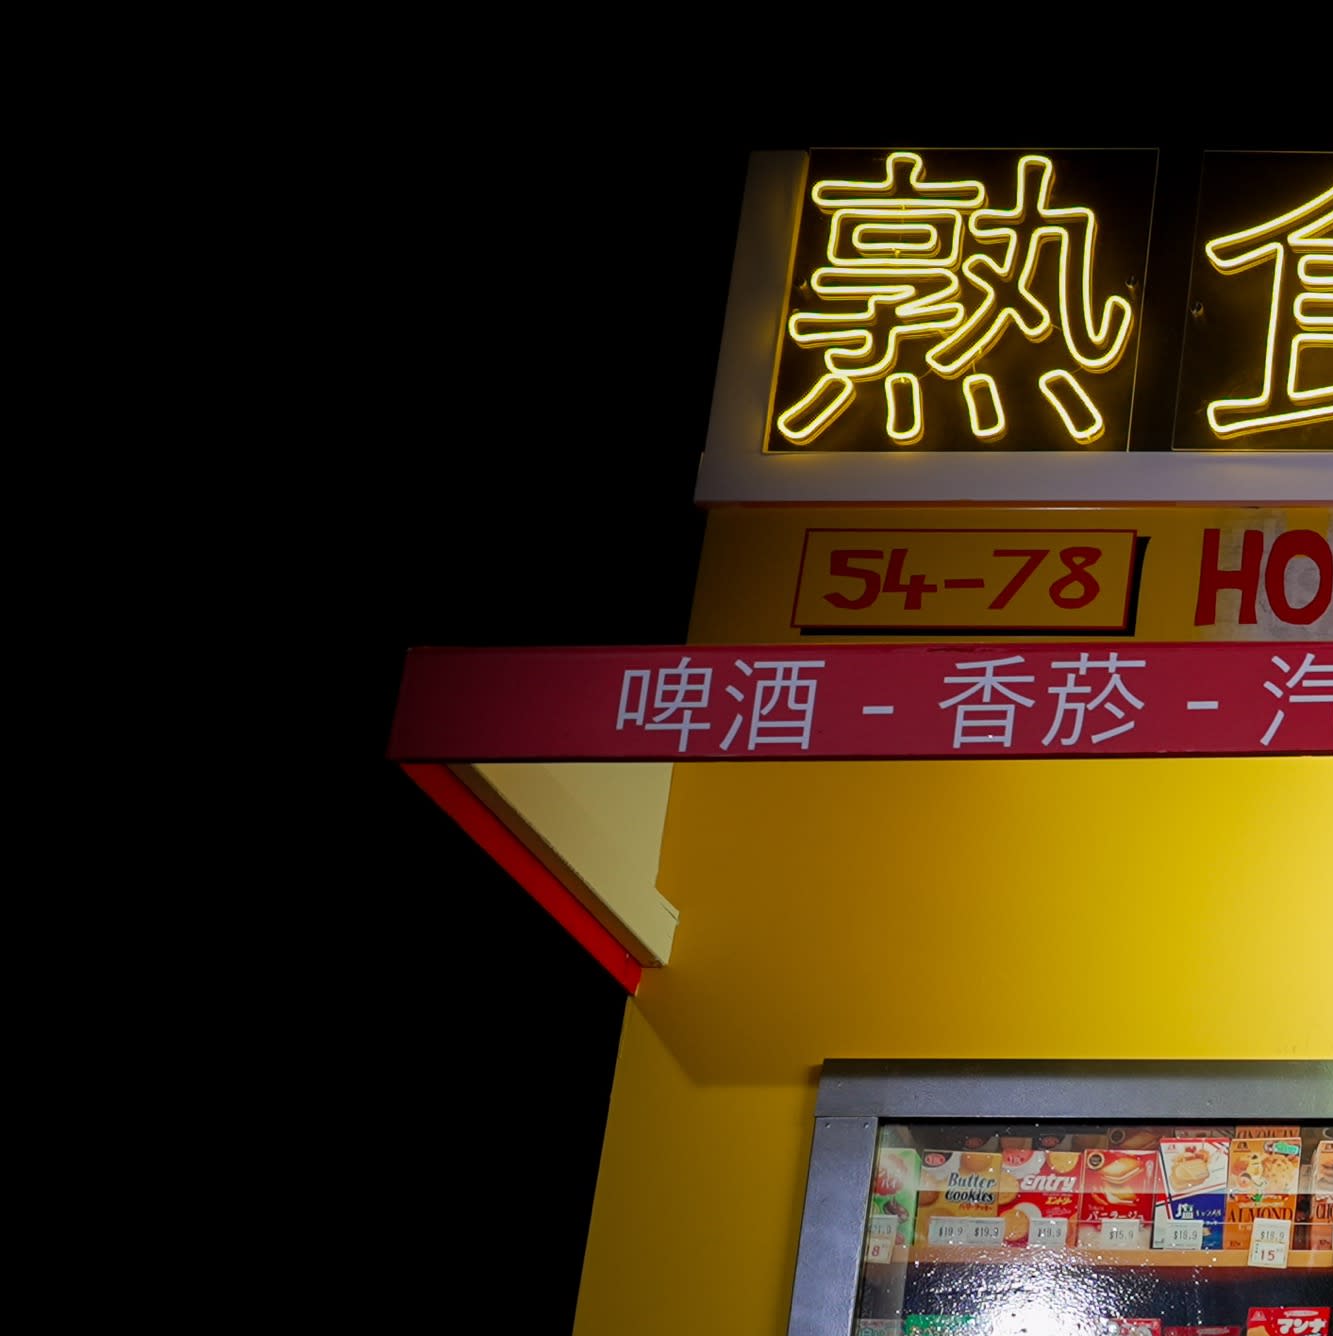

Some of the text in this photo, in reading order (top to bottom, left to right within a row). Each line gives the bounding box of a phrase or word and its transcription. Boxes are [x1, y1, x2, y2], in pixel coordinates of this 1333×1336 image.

[823, 546, 1103, 611] 54-78
[614, 656, 826, 751] 啤酒
[938, 653, 1147, 748] 香菸
[947, 1172, 996, 1188] Butter
